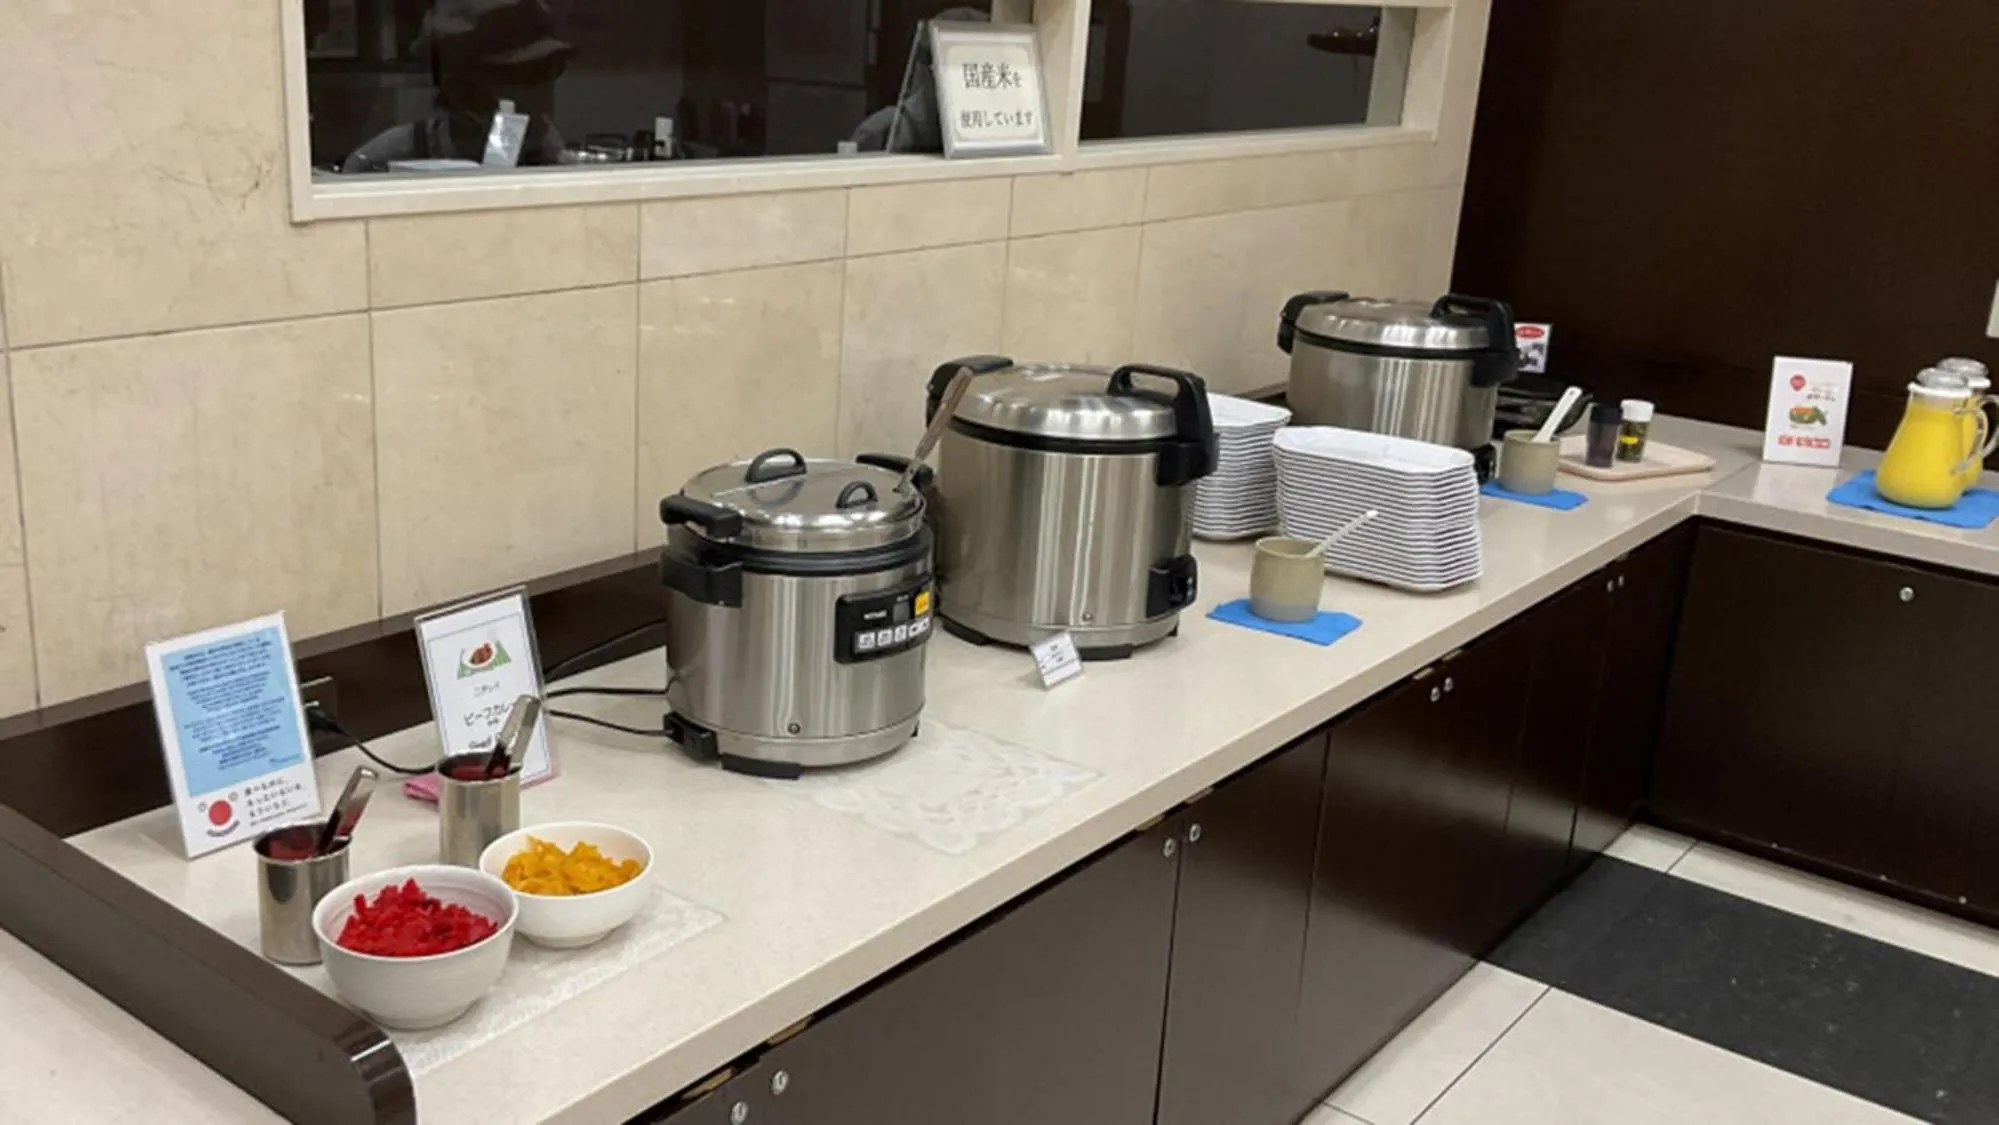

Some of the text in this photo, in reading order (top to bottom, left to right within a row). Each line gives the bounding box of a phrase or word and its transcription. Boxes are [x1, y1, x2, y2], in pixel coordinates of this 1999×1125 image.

[962, 62, 1022, 90] 国産米を
[961, 109, 1033, 129] 使用しています
[463, 703, 511, 727] ビーフカレ
